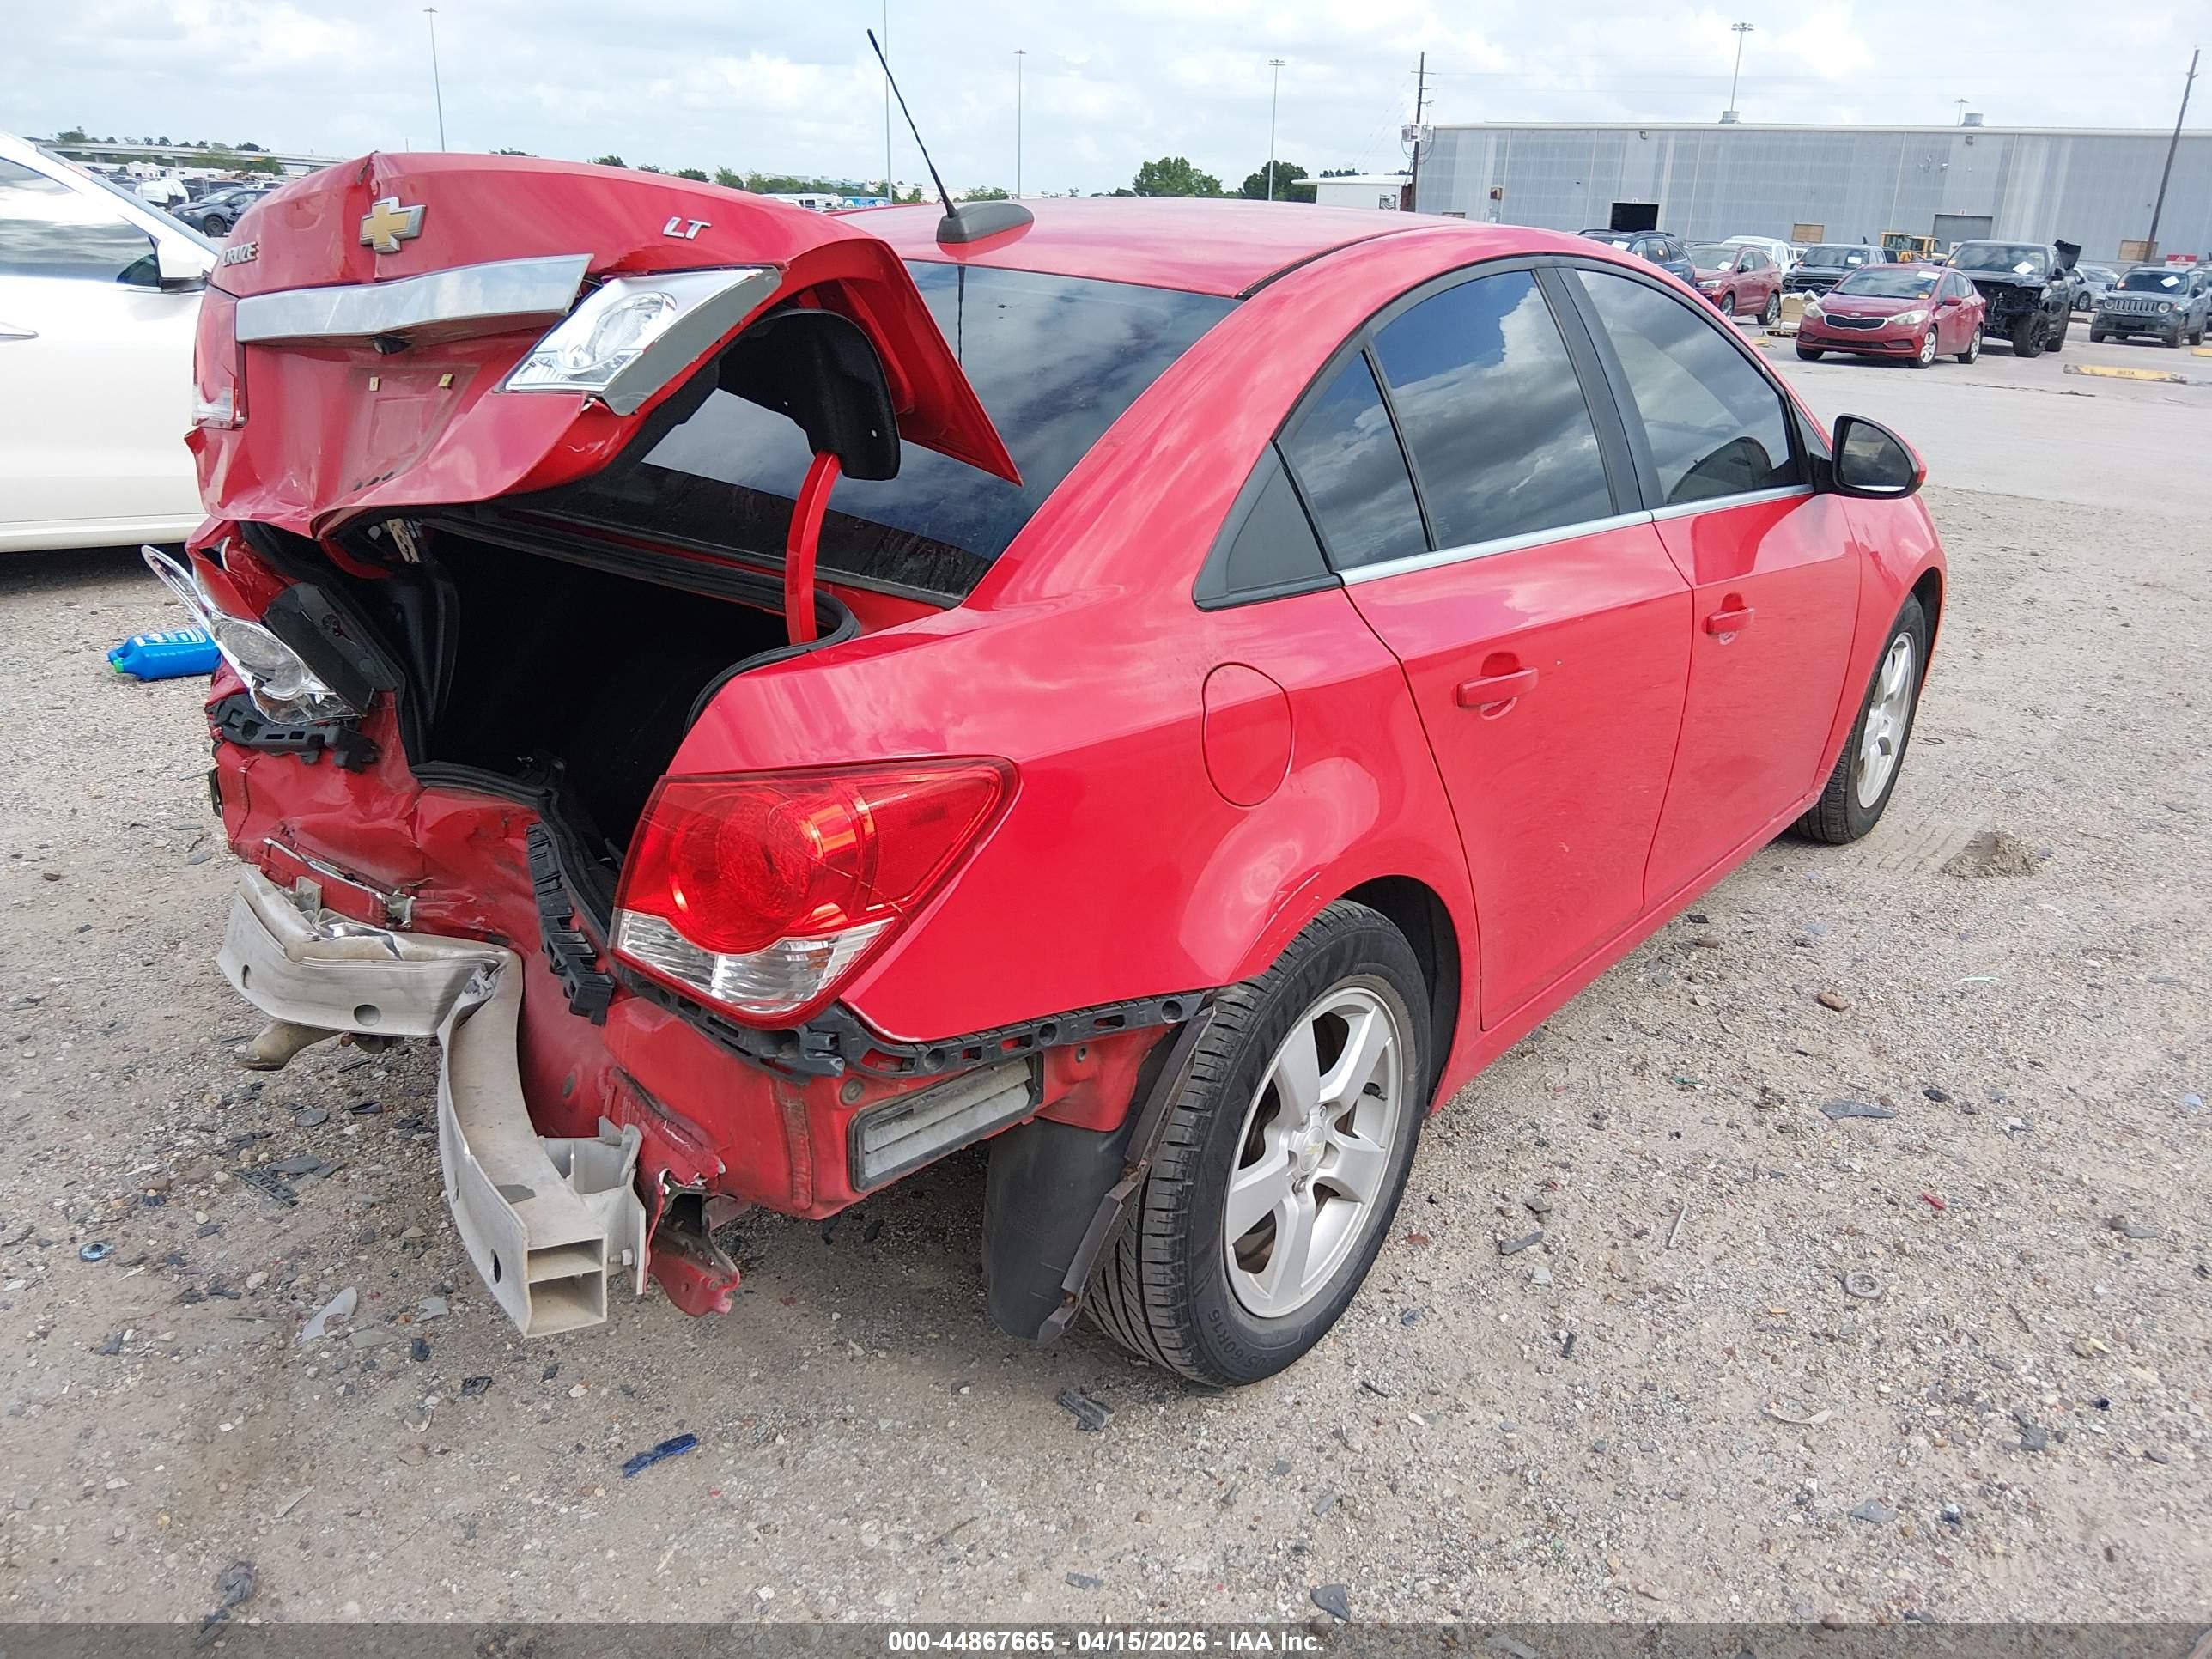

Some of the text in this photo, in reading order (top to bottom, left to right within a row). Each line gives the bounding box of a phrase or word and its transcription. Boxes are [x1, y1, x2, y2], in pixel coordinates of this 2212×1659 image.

[662, 216, 713, 240] LT
[221, 241, 259, 268] CRUZE
[1207, 1308, 1271, 1370] 05/60R16
